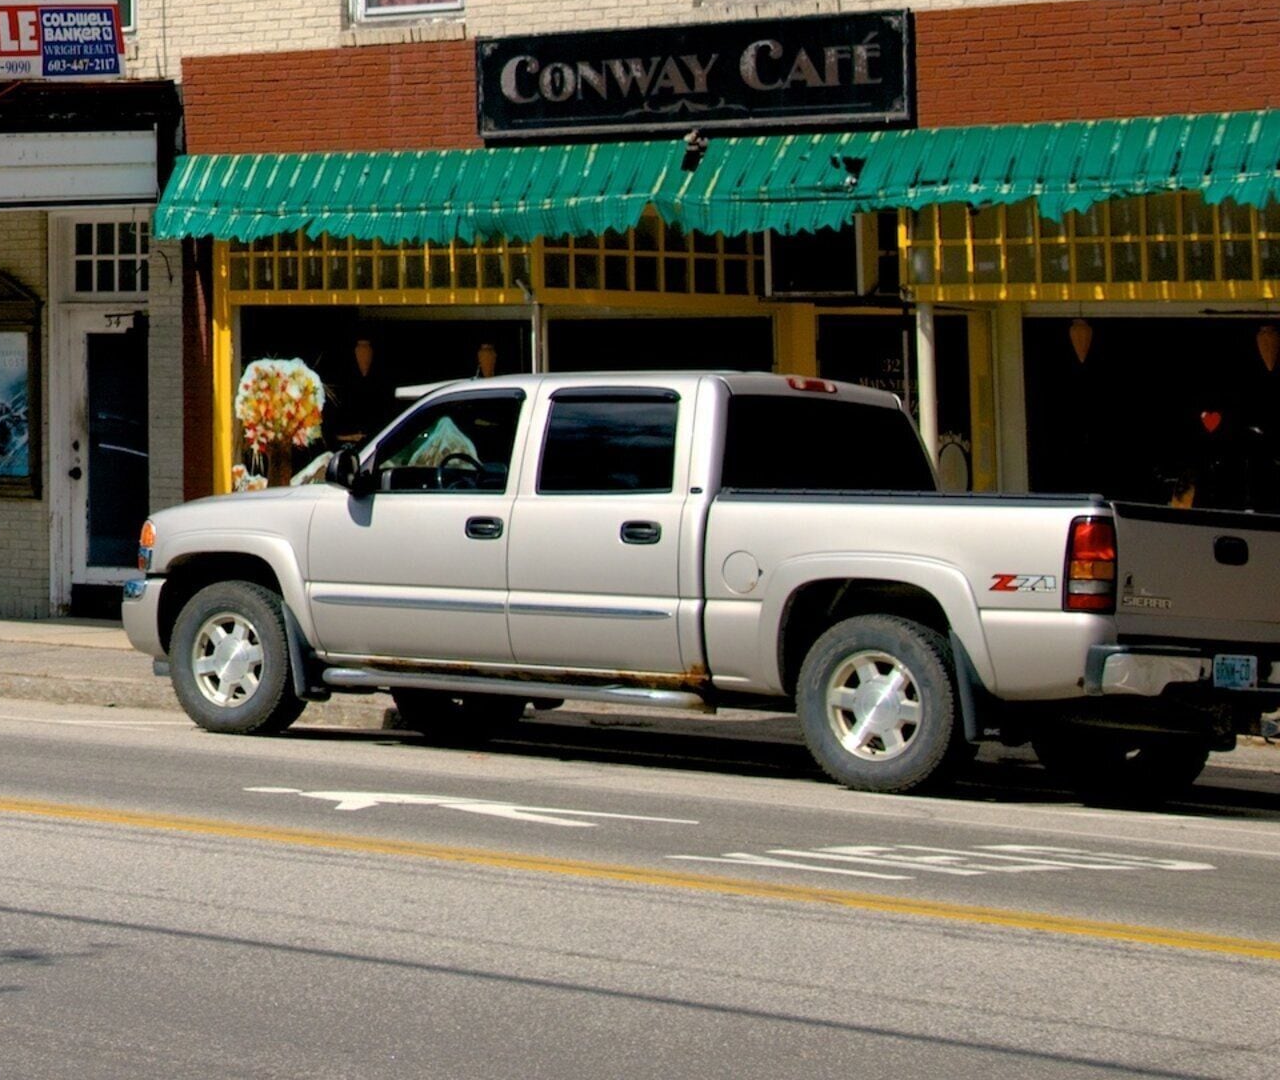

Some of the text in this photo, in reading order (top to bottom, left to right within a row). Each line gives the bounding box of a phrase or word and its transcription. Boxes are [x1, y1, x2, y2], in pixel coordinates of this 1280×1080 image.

[42, 12, 112, 27] COLDWELL
[44, 27, 102, 44] BANKER
[44, 43, 115, 55] WRIGHT REALTY
[500, 31, 883, 105] CONWAY CAFÉ
[883, 358, 901, 373] 32
[988, 574, 1057, 591] Z71
[1122, 596, 1172, 609] SIERRA
